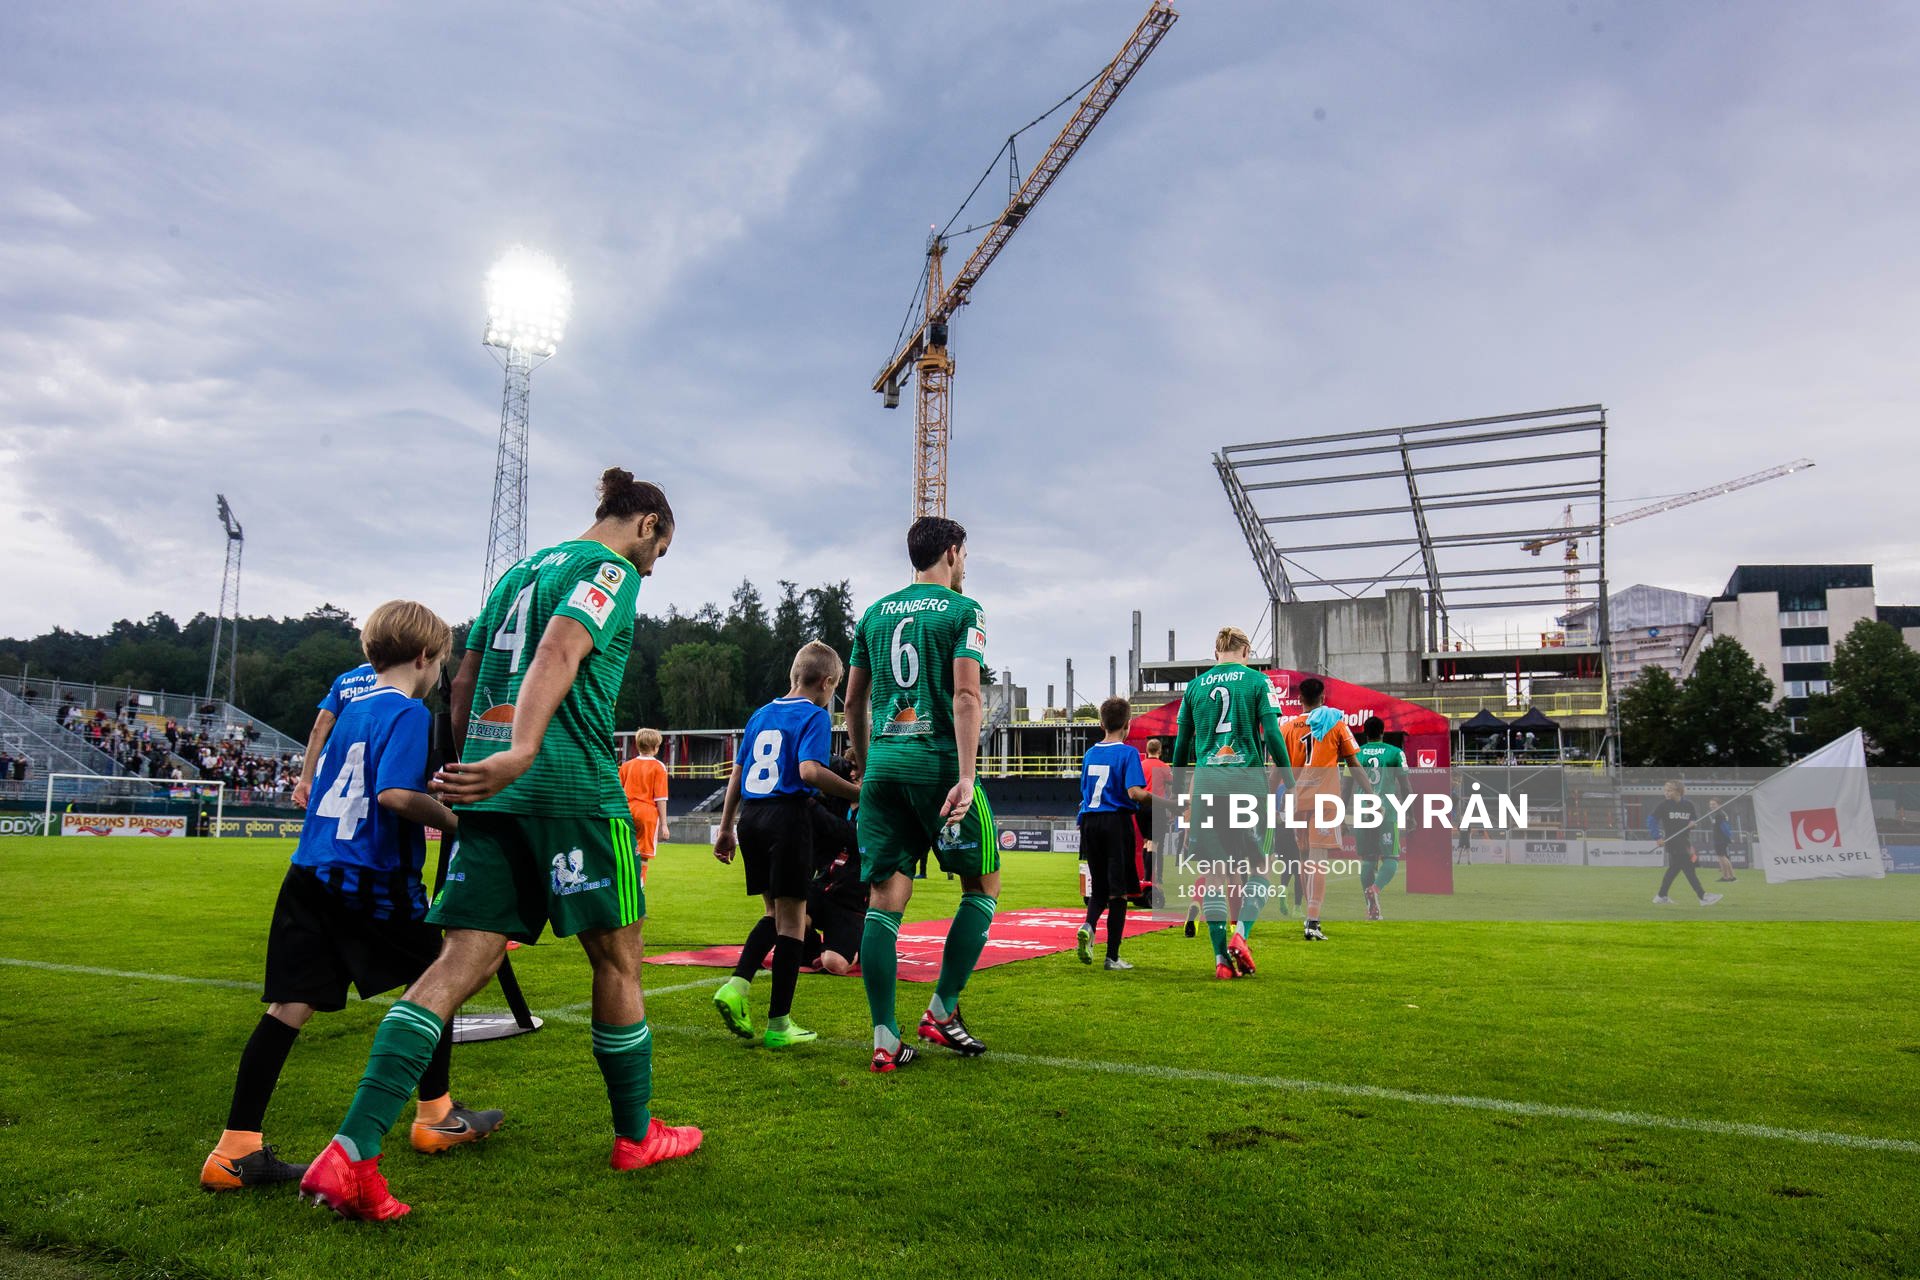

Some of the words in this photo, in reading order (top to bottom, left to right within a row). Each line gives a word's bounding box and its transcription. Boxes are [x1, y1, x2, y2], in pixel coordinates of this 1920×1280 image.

[880, 598, 950, 616] TRANBERG
[492, 581, 537, 673] 4
[890, 616, 920, 688] 6
[1200, 671, 1246, 687] LÖFKVIST
[1209, 686, 1232, 734] 2
[744, 729, 783, 795] 8
[1300, 732, 1313, 766] 1
[1087, 764, 1110, 809] 7
[1367, 757, 1381, 785] 3
[315, 741, 370, 840] 4
[64, 815, 125, 828] PARSONS
[128, 817, 185, 830] PARSONS
[209, 820, 240, 836] gbon
[246, 820, 275, 837] gibon
[1773, 854, 1835, 866] SVENSKA
[1839, 851, 1872, 862] SPEL
